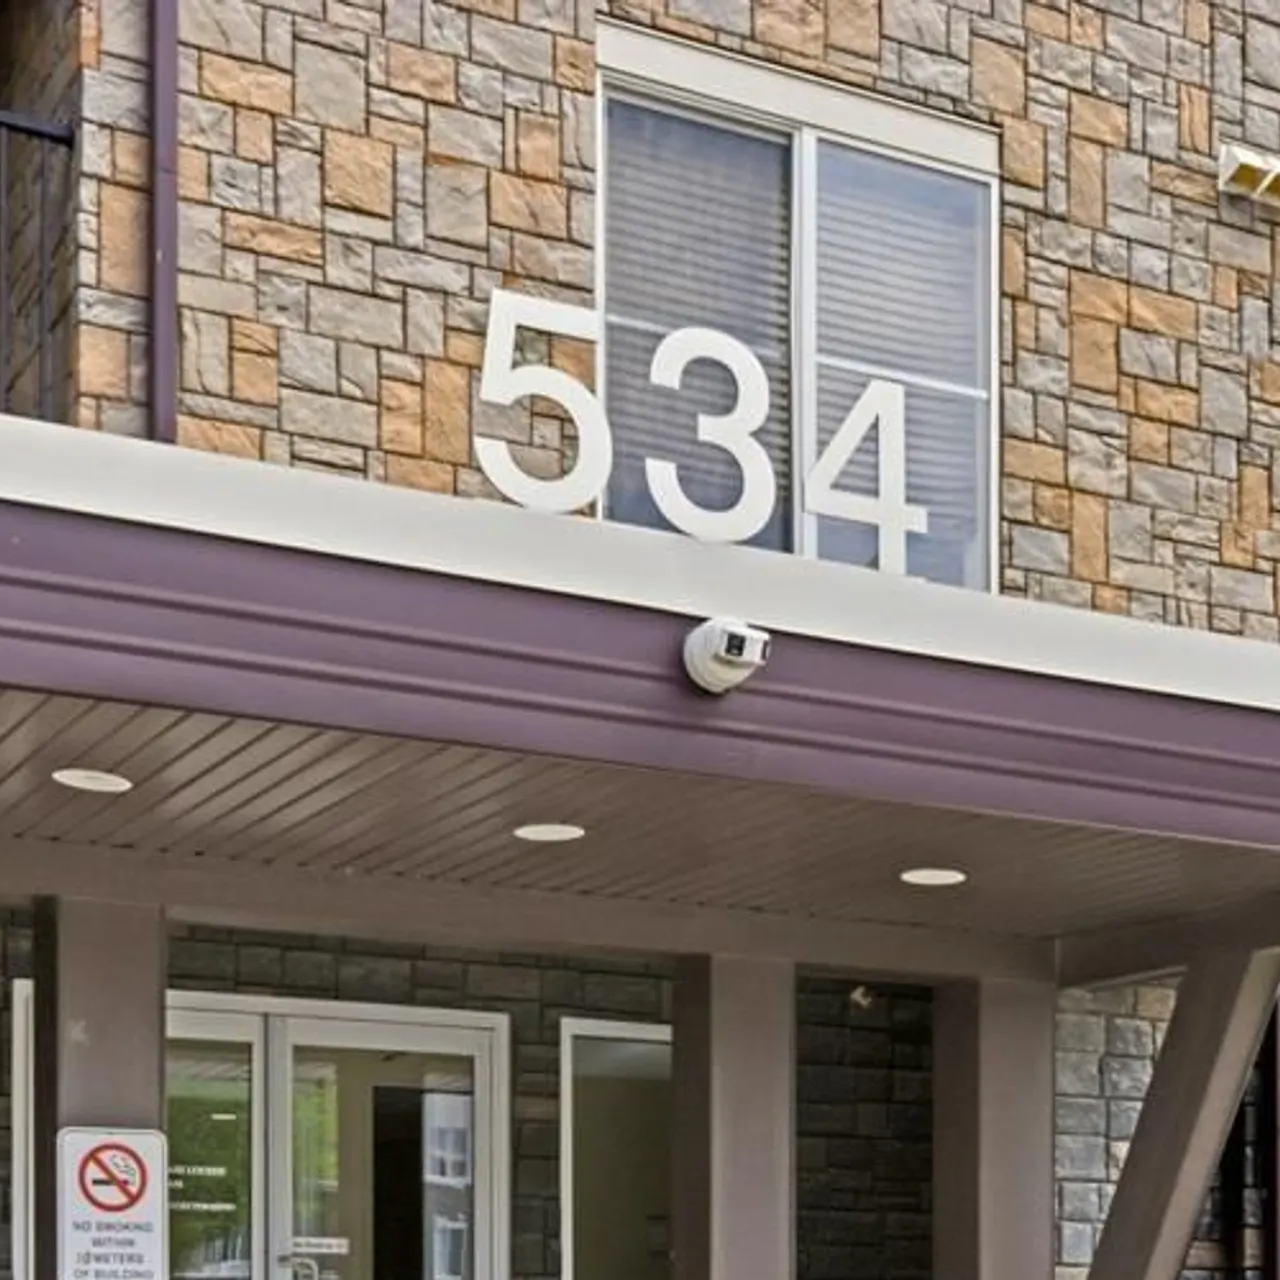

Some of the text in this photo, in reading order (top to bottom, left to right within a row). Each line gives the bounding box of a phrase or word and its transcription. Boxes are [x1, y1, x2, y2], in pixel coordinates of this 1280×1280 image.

[474, 287, 928, 575] 534
[72, 1220, 154, 1233] NO SMOKING
[94, 1268, 154, 1280] BUILDING
